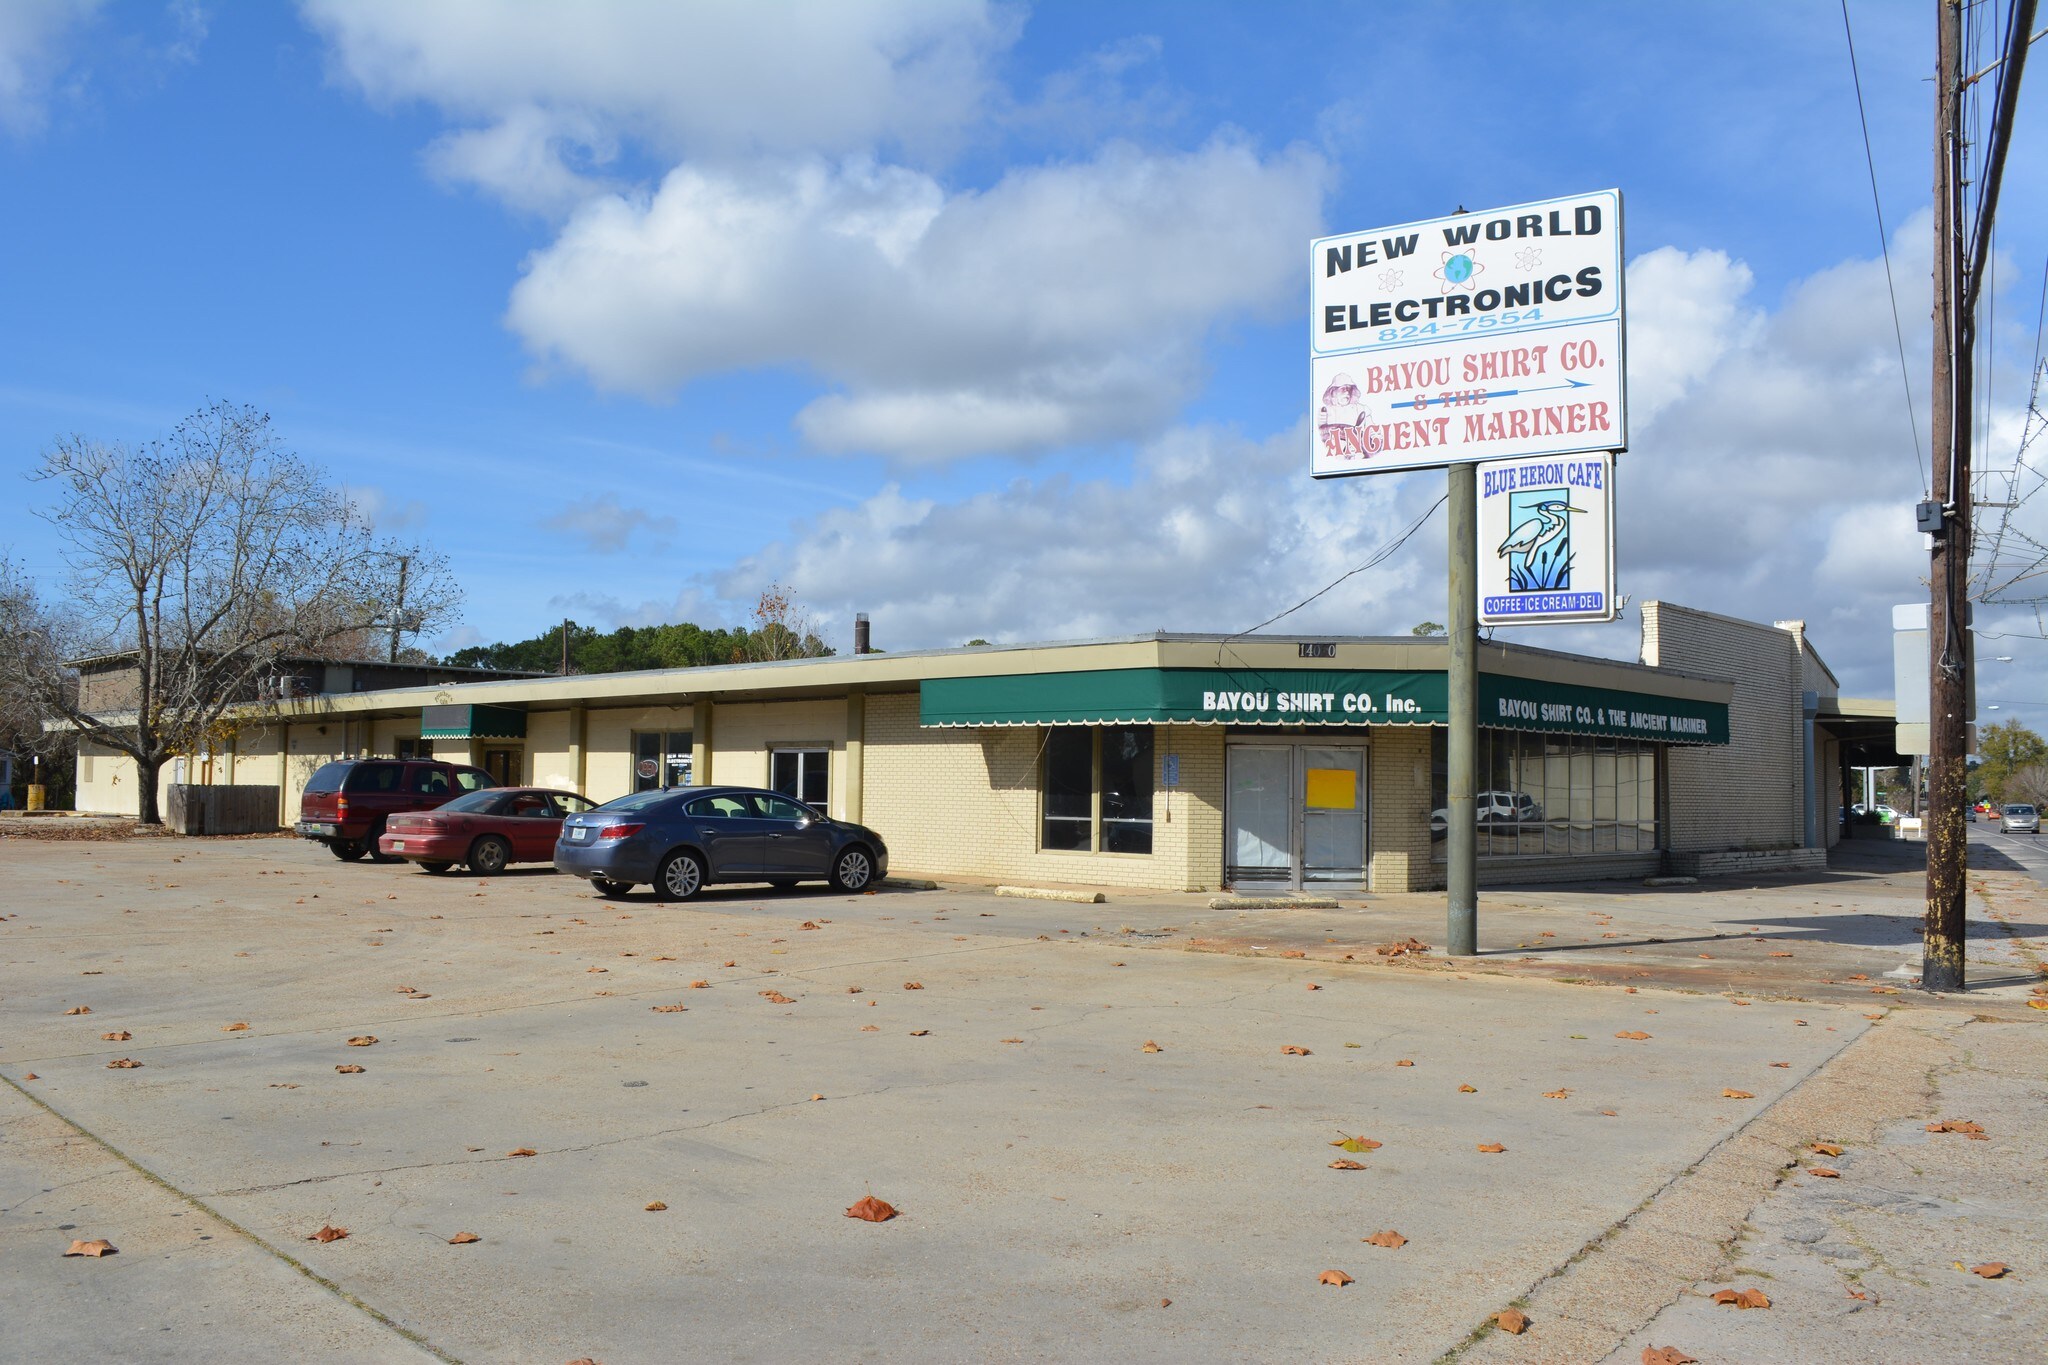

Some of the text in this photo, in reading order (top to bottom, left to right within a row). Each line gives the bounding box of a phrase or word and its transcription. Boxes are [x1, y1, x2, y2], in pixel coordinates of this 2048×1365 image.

[1326, 204, 1602, 278] NEW WORLD
[1324, 266, 1603, 333] ELECTRONICS
[1378, 308, 1545, 342] 824-7554
[1366, 340, 1605, 394] BAYOU SHIRT CO.
[1413, 388, 1488, 411] & THE
[1325, 401, 1611, 459] ANCIENT MARINER
[1484, 462, 1602, 498] BLUE HERON CAFE
[1203, 691, 1422, 714] BAYOU SHIRT CO. Inc.
[1498, 698, 1708, 735] BAYOU SHIRT CO. & THE ANCIENT MARINER
